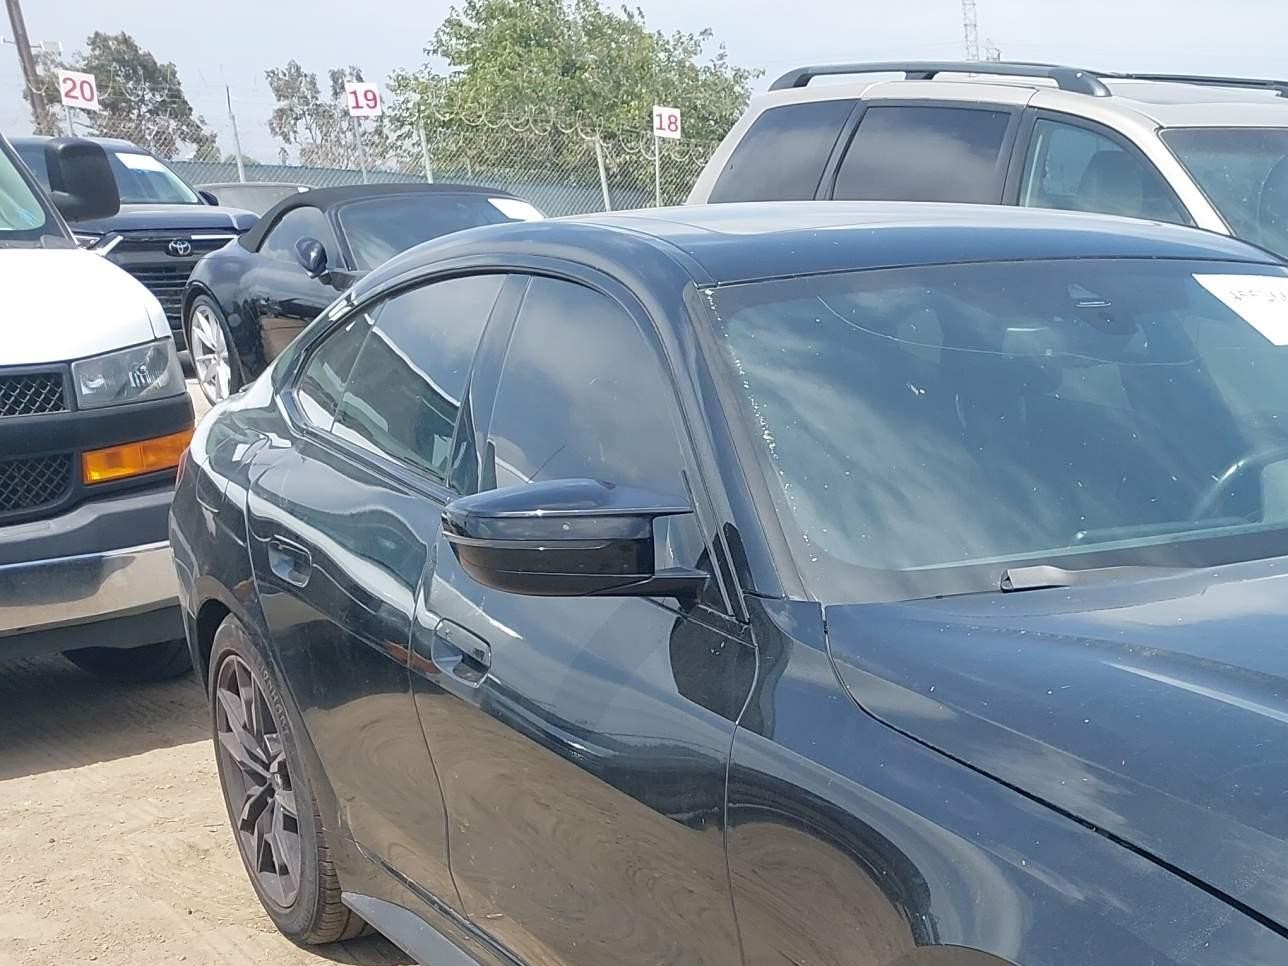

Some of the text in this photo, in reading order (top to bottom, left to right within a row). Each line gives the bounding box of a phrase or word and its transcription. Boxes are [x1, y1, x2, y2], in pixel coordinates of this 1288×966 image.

[62, 77, 94, 102] 20
[349, 90, 378, 109] 19
[656, 113, 678, 132] 18
